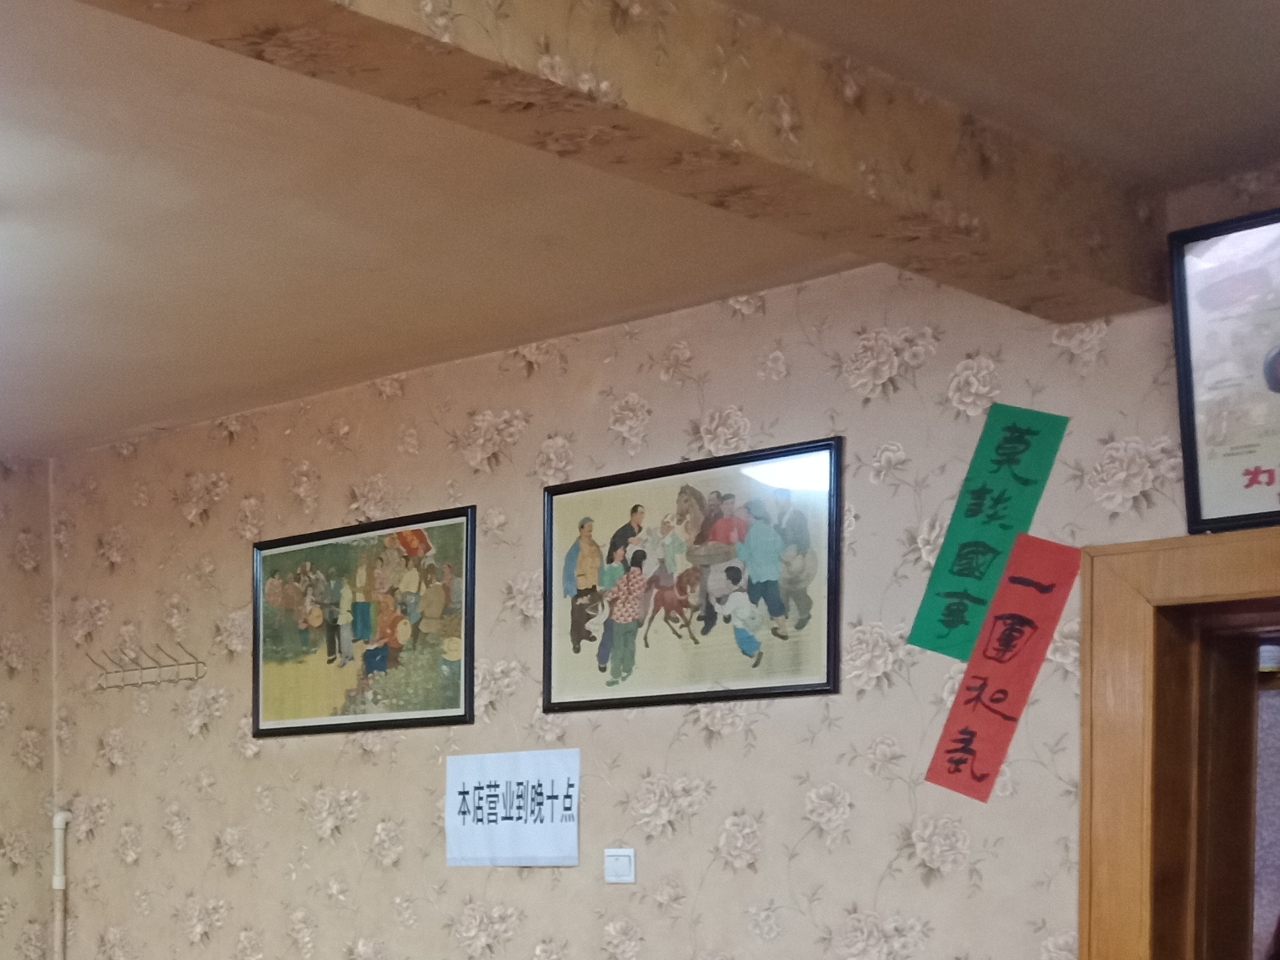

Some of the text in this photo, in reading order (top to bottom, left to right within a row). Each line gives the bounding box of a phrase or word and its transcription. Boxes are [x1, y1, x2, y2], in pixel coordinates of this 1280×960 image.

[457, 777, 575, 826] 本店营业到晚十点
